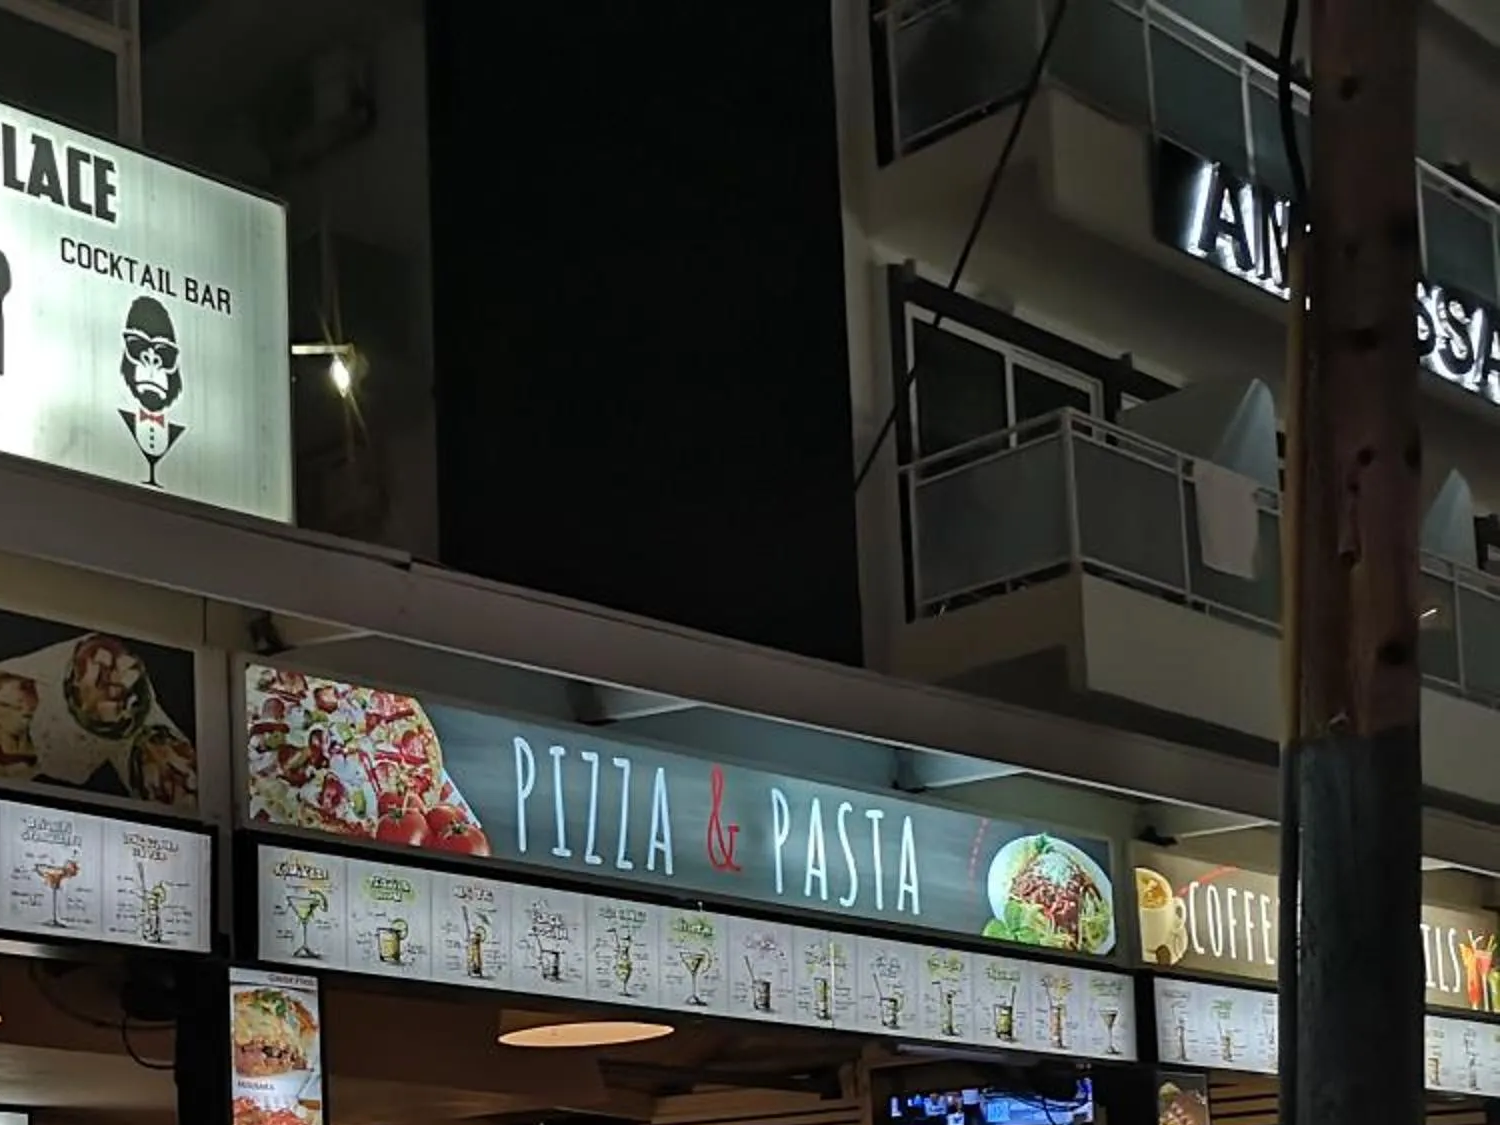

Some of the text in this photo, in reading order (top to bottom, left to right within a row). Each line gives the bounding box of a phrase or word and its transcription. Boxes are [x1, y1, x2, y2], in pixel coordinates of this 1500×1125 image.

[60, 237, 232, 315] COCKTAIL BAR
[513, 736, 920, 915] PIZZA & PASTA
[1189, 881, 1280, 966] COFFE
